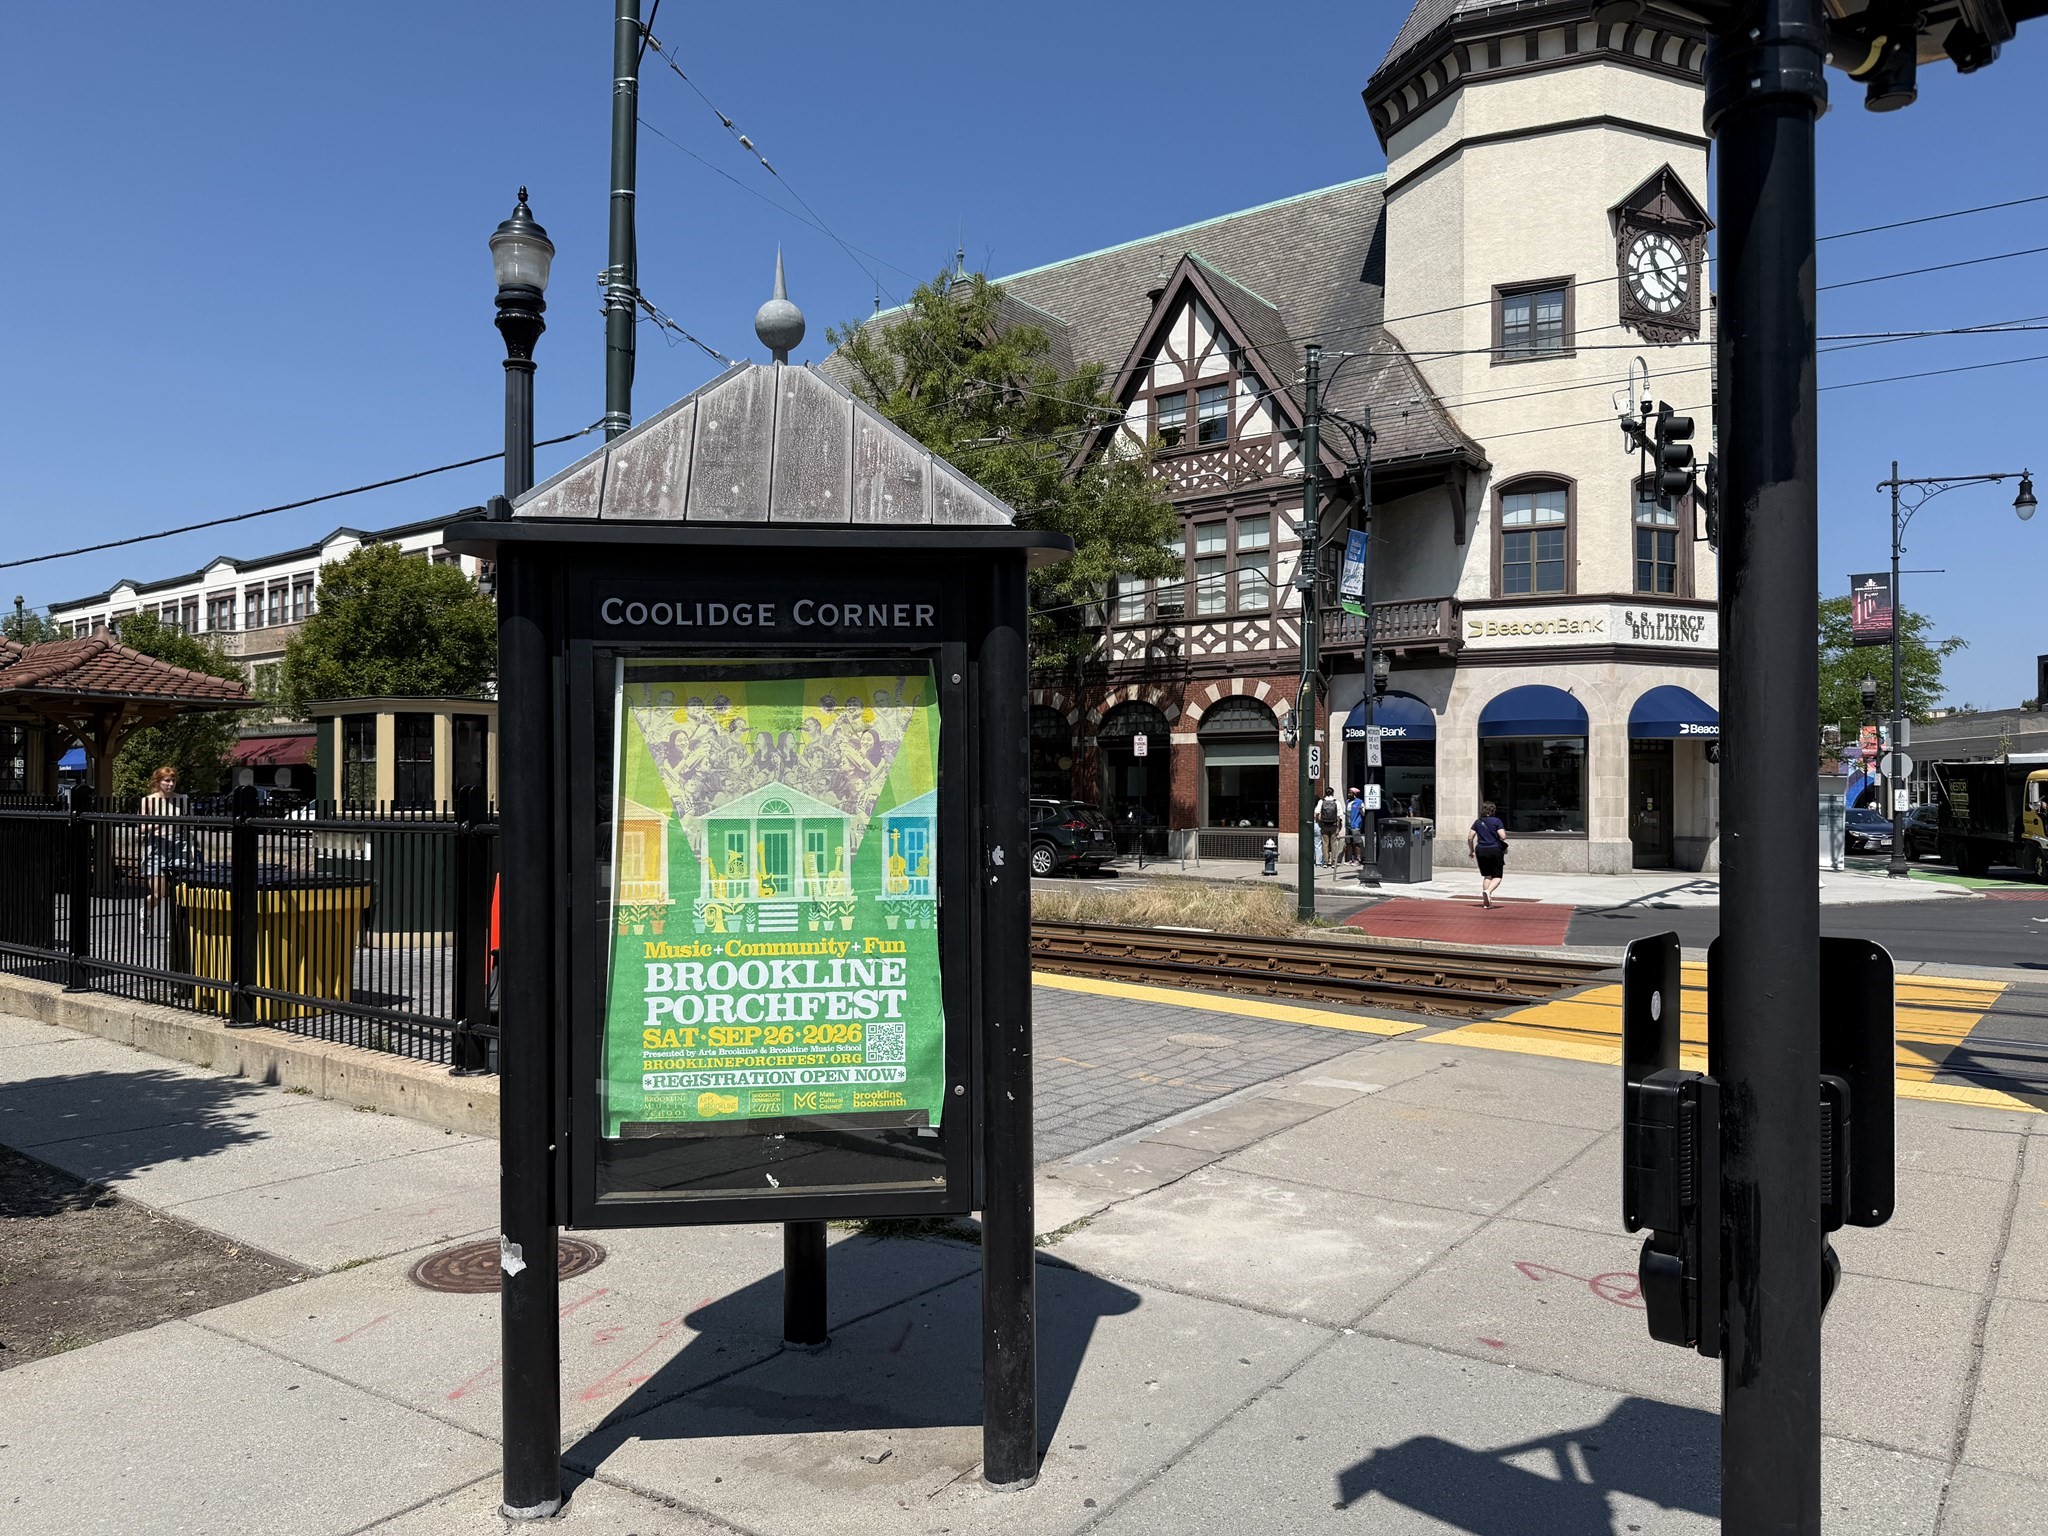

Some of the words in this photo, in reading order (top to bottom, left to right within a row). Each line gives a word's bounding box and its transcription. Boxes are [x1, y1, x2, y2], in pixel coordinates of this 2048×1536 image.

[601, 598, 775, 626] COOLIDGE
[793, 599, 935, 627] CORNER
[1485, 617, 1604, 636] BeaconBank
[1625, 611, 1637, 627] S.
[1640, 612, 1652, 627] S.
[1656, 612, 1706, 631] PIERCE
[1632, 624, 1700, 642] BUILDING
[1350, 727, 1407, 737] BeaBank
[1690, 724, 1719, 734] Beaco
[1311, 749, 1318, 762] S
[1310, 765, 1319, 776] 10
[644, 940, 712, 959] Music
[724, 937, 850, 958] Community
[862, 937, 907, 954] Fun
[643, 958, 907, 992] BROOKLINE
[643, 989, 907, 1026] PORCHFEST
[643, 1049, 685, 1058] Presented
[686, 1049, 696, 1058] by
[699, 1048, 717, 1056] Arts
[719, 1047, 758, 1055] Brookline
[769, 1045, 808, 1054] Brookline
[836, 1044, 862, 1052] School
[800, 1069, 850, 1084] OPEN
[853, 1090, 903, 1099] brookline
[853, 1098, 906, 1108] booksmith
